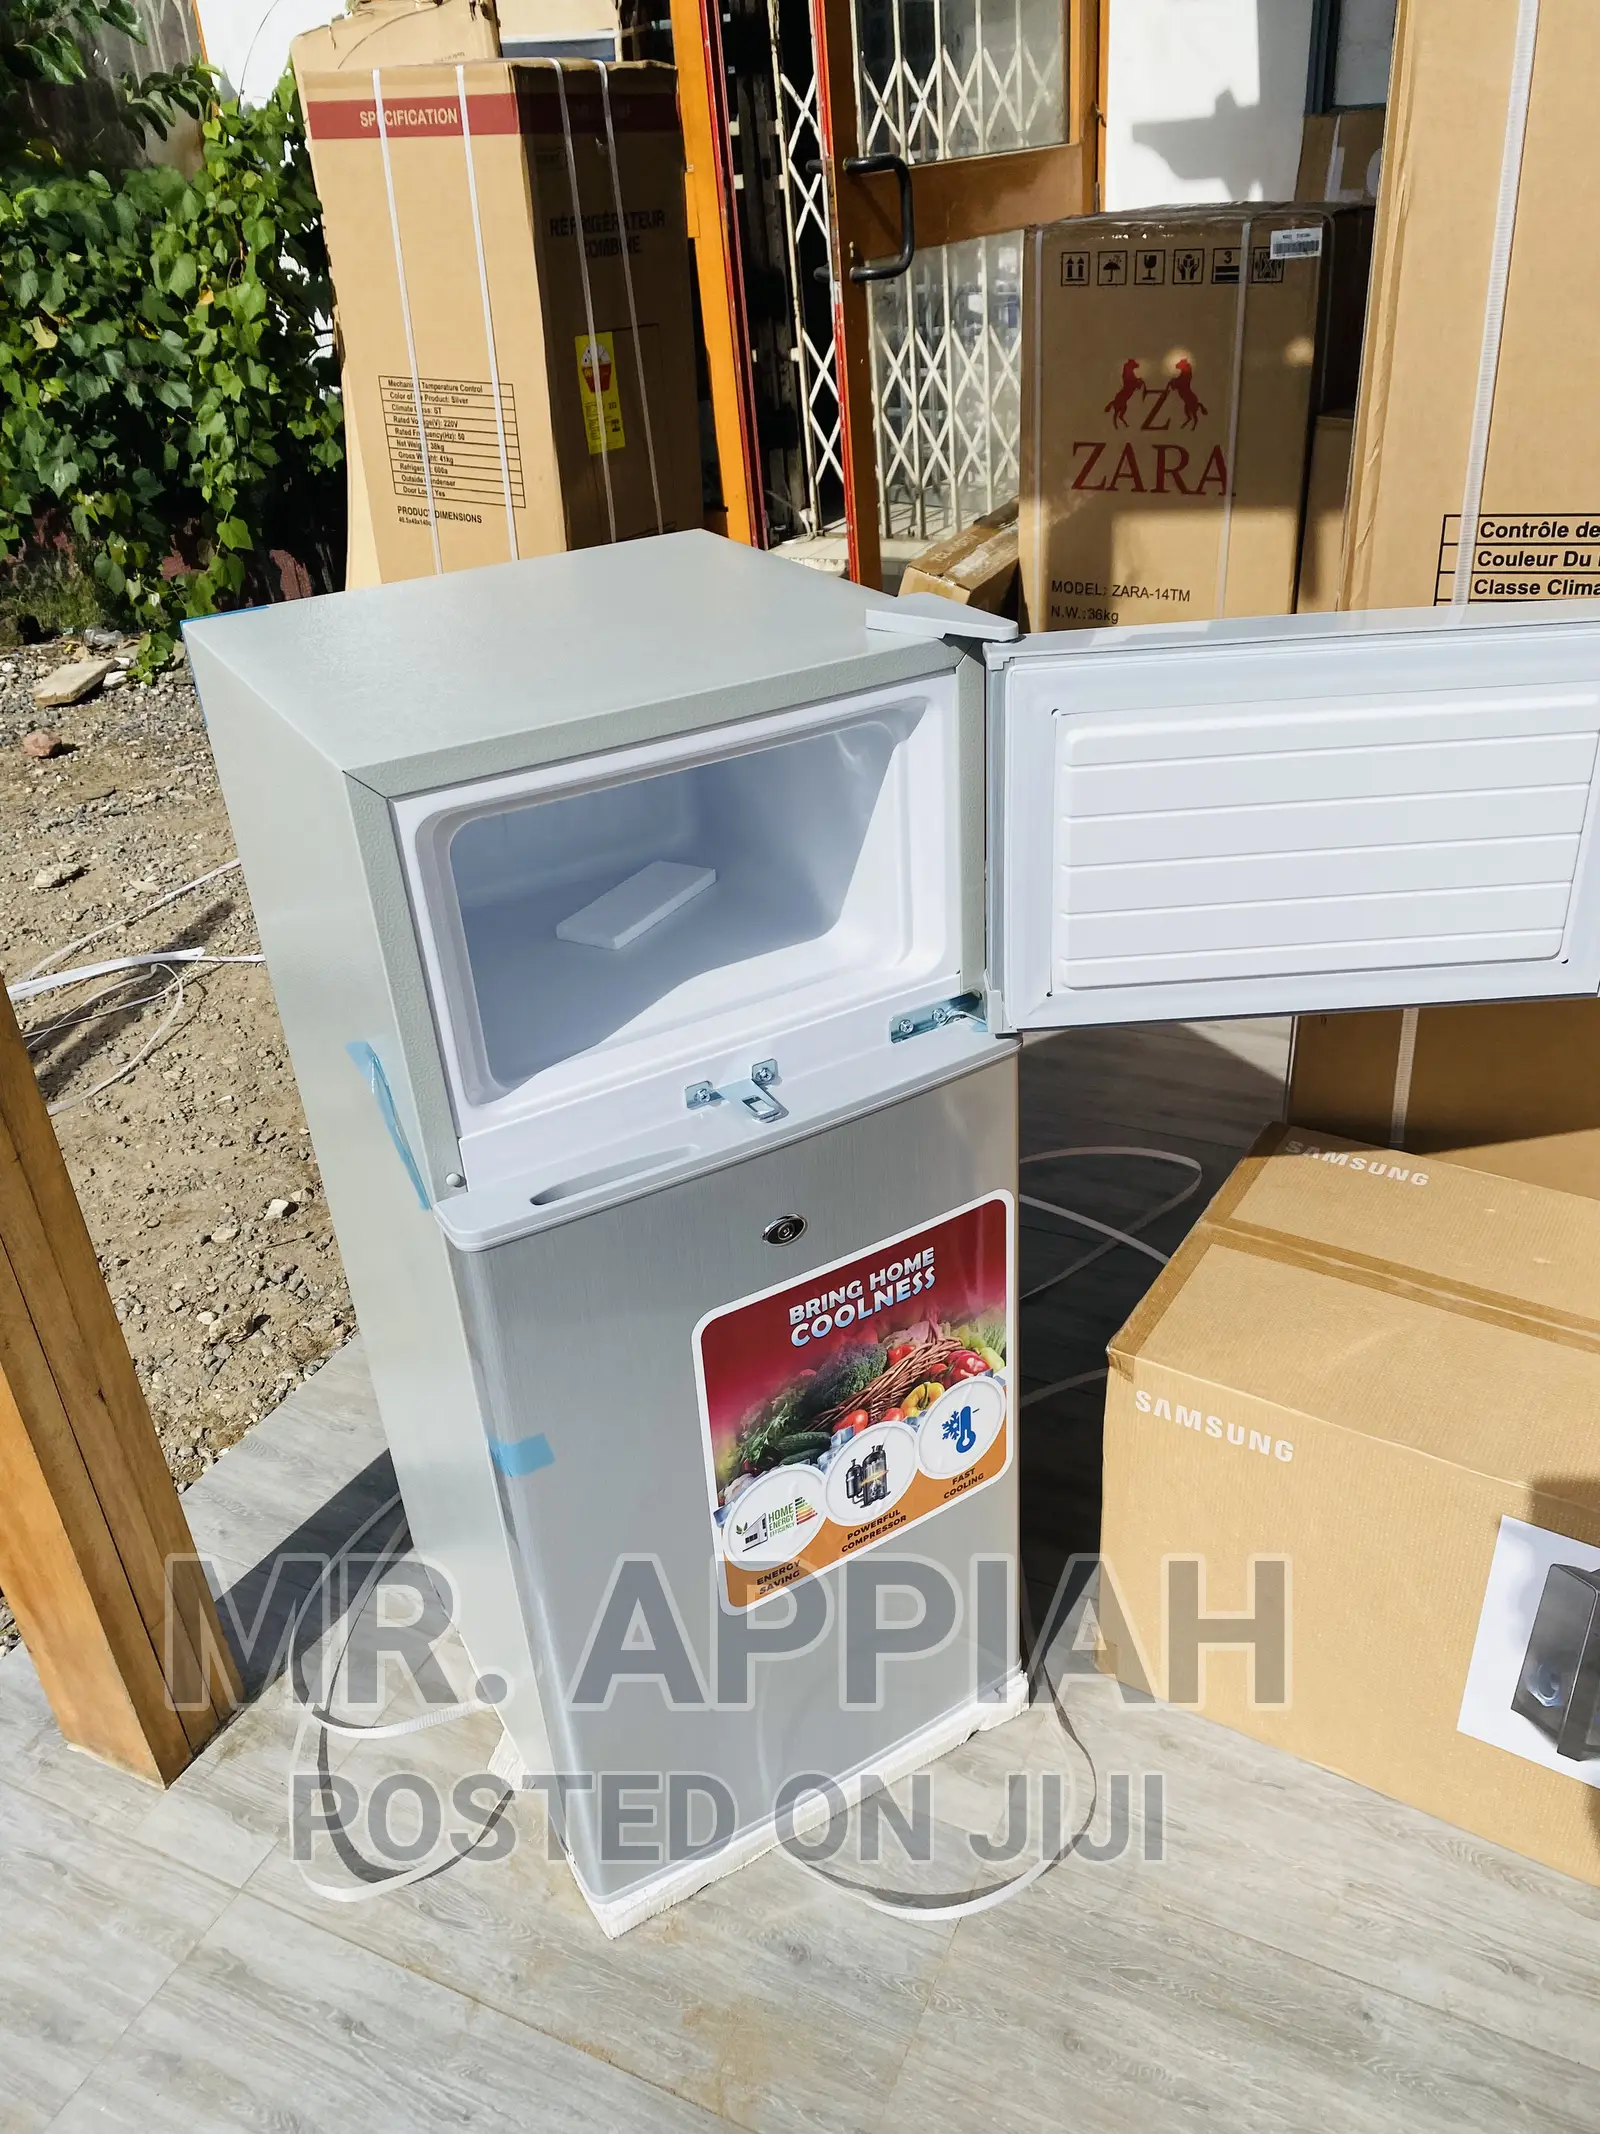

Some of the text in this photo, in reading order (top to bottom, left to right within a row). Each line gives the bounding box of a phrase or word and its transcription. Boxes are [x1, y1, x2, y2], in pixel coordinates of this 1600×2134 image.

[359, 107, 458, 128] SPCIFICATION
[1223, 250, 1232, 264] 3
[422, 382, 459, 392] Temperature
[459, 384, 483, 393] Control
[390, 392, 406, 400] Color
[407, 393, 412, 401] of
[451, 396, 469, 404] Silver
[391, 404, 413, 412] Climate
[393, 416, 410, 424] Rated
[443, 420, 458, 428] 220V
[395, 428, 411, 436] Rated
[398, 451, 416, 460] Gross
[1071, 441, 1236, 496] ZARA
[401, 474, 423, 483] Outside
[403, 486, 417, 494] Door
[397, 505, 482, 523] PRODUC DIMENSIONS
[1480, 521, 1569, 538] Contrôle
[1477, 550, 1591, 567] Couleur Du
[1051, 580, 1190, 602] MODEL: ZARA-14TM
[1474, 579, 1540, 595] Classe
[1285, 1140, 1429, 1186] SAMSUNG
[788, 1246, 935, 1325] BRING HOME
[790, 1265, 936, 1347] COOLNESS
[1135, 1390, 1294, 1462] SAMSUNG
[952, 1467, 976, 1485] FAST
[943, 1472, 984, 1499] COOLING
[768, 1502, 794, 1523] HOME
[768, 1514, 794, 1531] ENERGY
[769, 1522, 795, 1537] EFFICIENCY
[847, 1509, 900, 1540] POWERFUL
[841, 1515, 907, 1552] COMPRESSOR
[756, 1560, 801, 1585] ENERGY
[759, 1570, 800, 1594] SAVING
